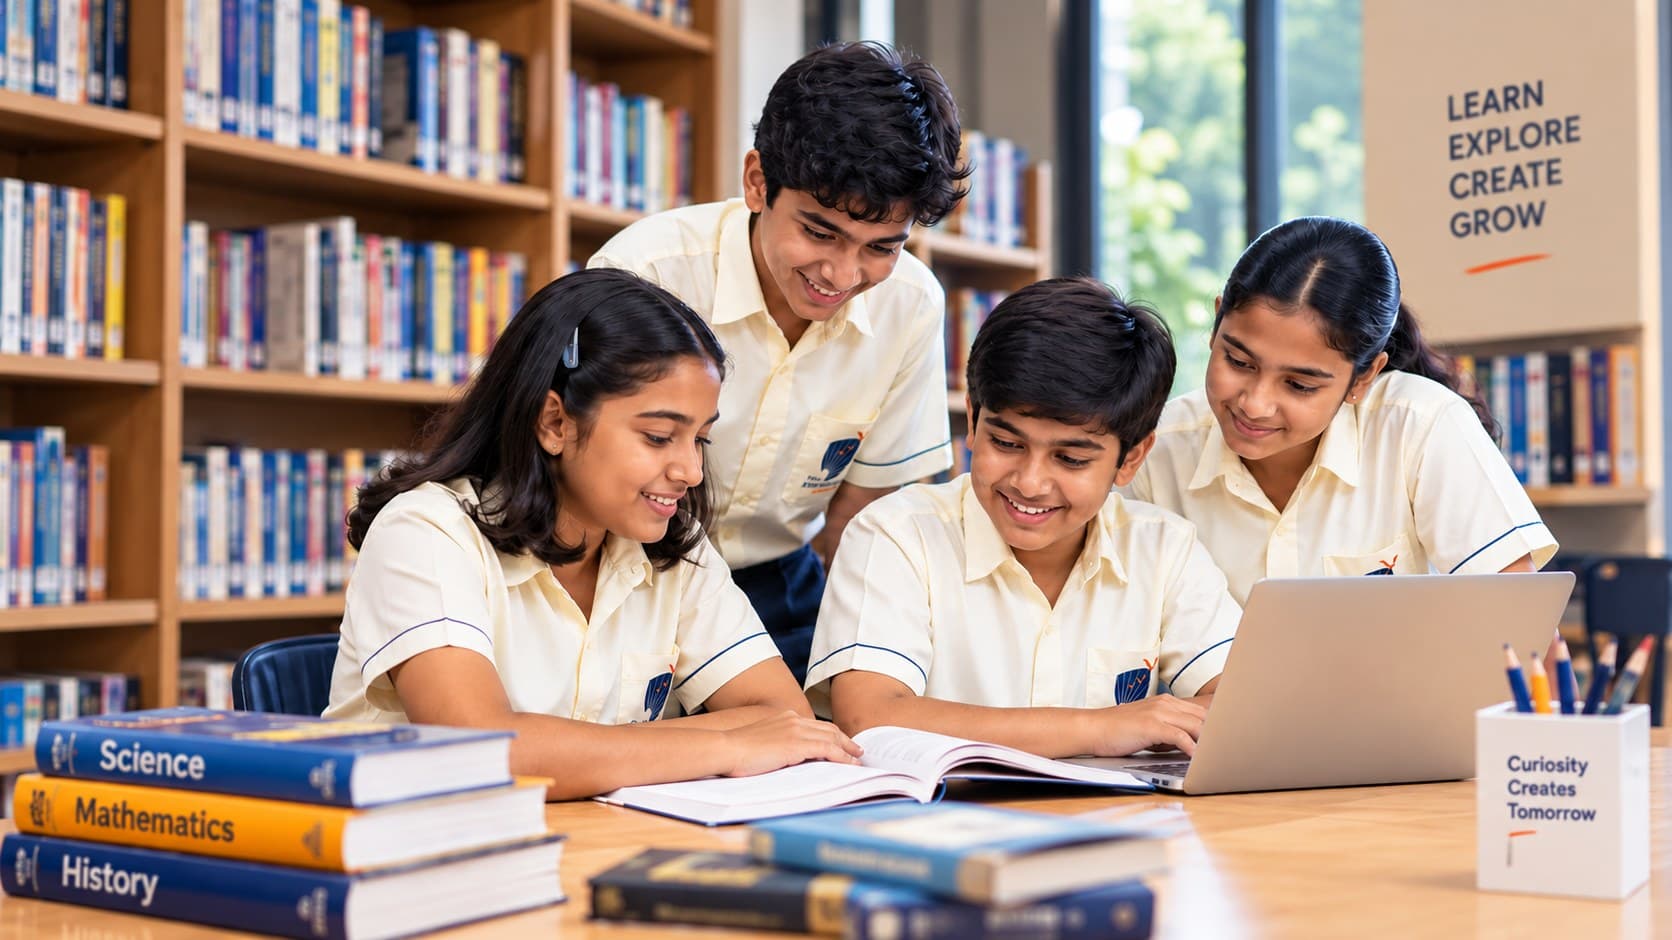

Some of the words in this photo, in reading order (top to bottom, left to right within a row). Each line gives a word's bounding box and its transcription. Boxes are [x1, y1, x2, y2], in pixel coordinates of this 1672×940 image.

[1447, 80, 1543, 122] LEARN
[1449, 115, 1580, 161] EXPLORE
[1449, 158, 1562, 200] CREATE
[1450, 201, 1546, 238] GROW
[99, 739, 205, 780] Science
[1507, 755, 1588, 777] Curiosity
[1507, 779, 1577, 797] Creates
[75, 797, 235, 843] Mathematics
[1507, 802, 1596, 821] Tomorrow
[62, 854, 158, 907] History
